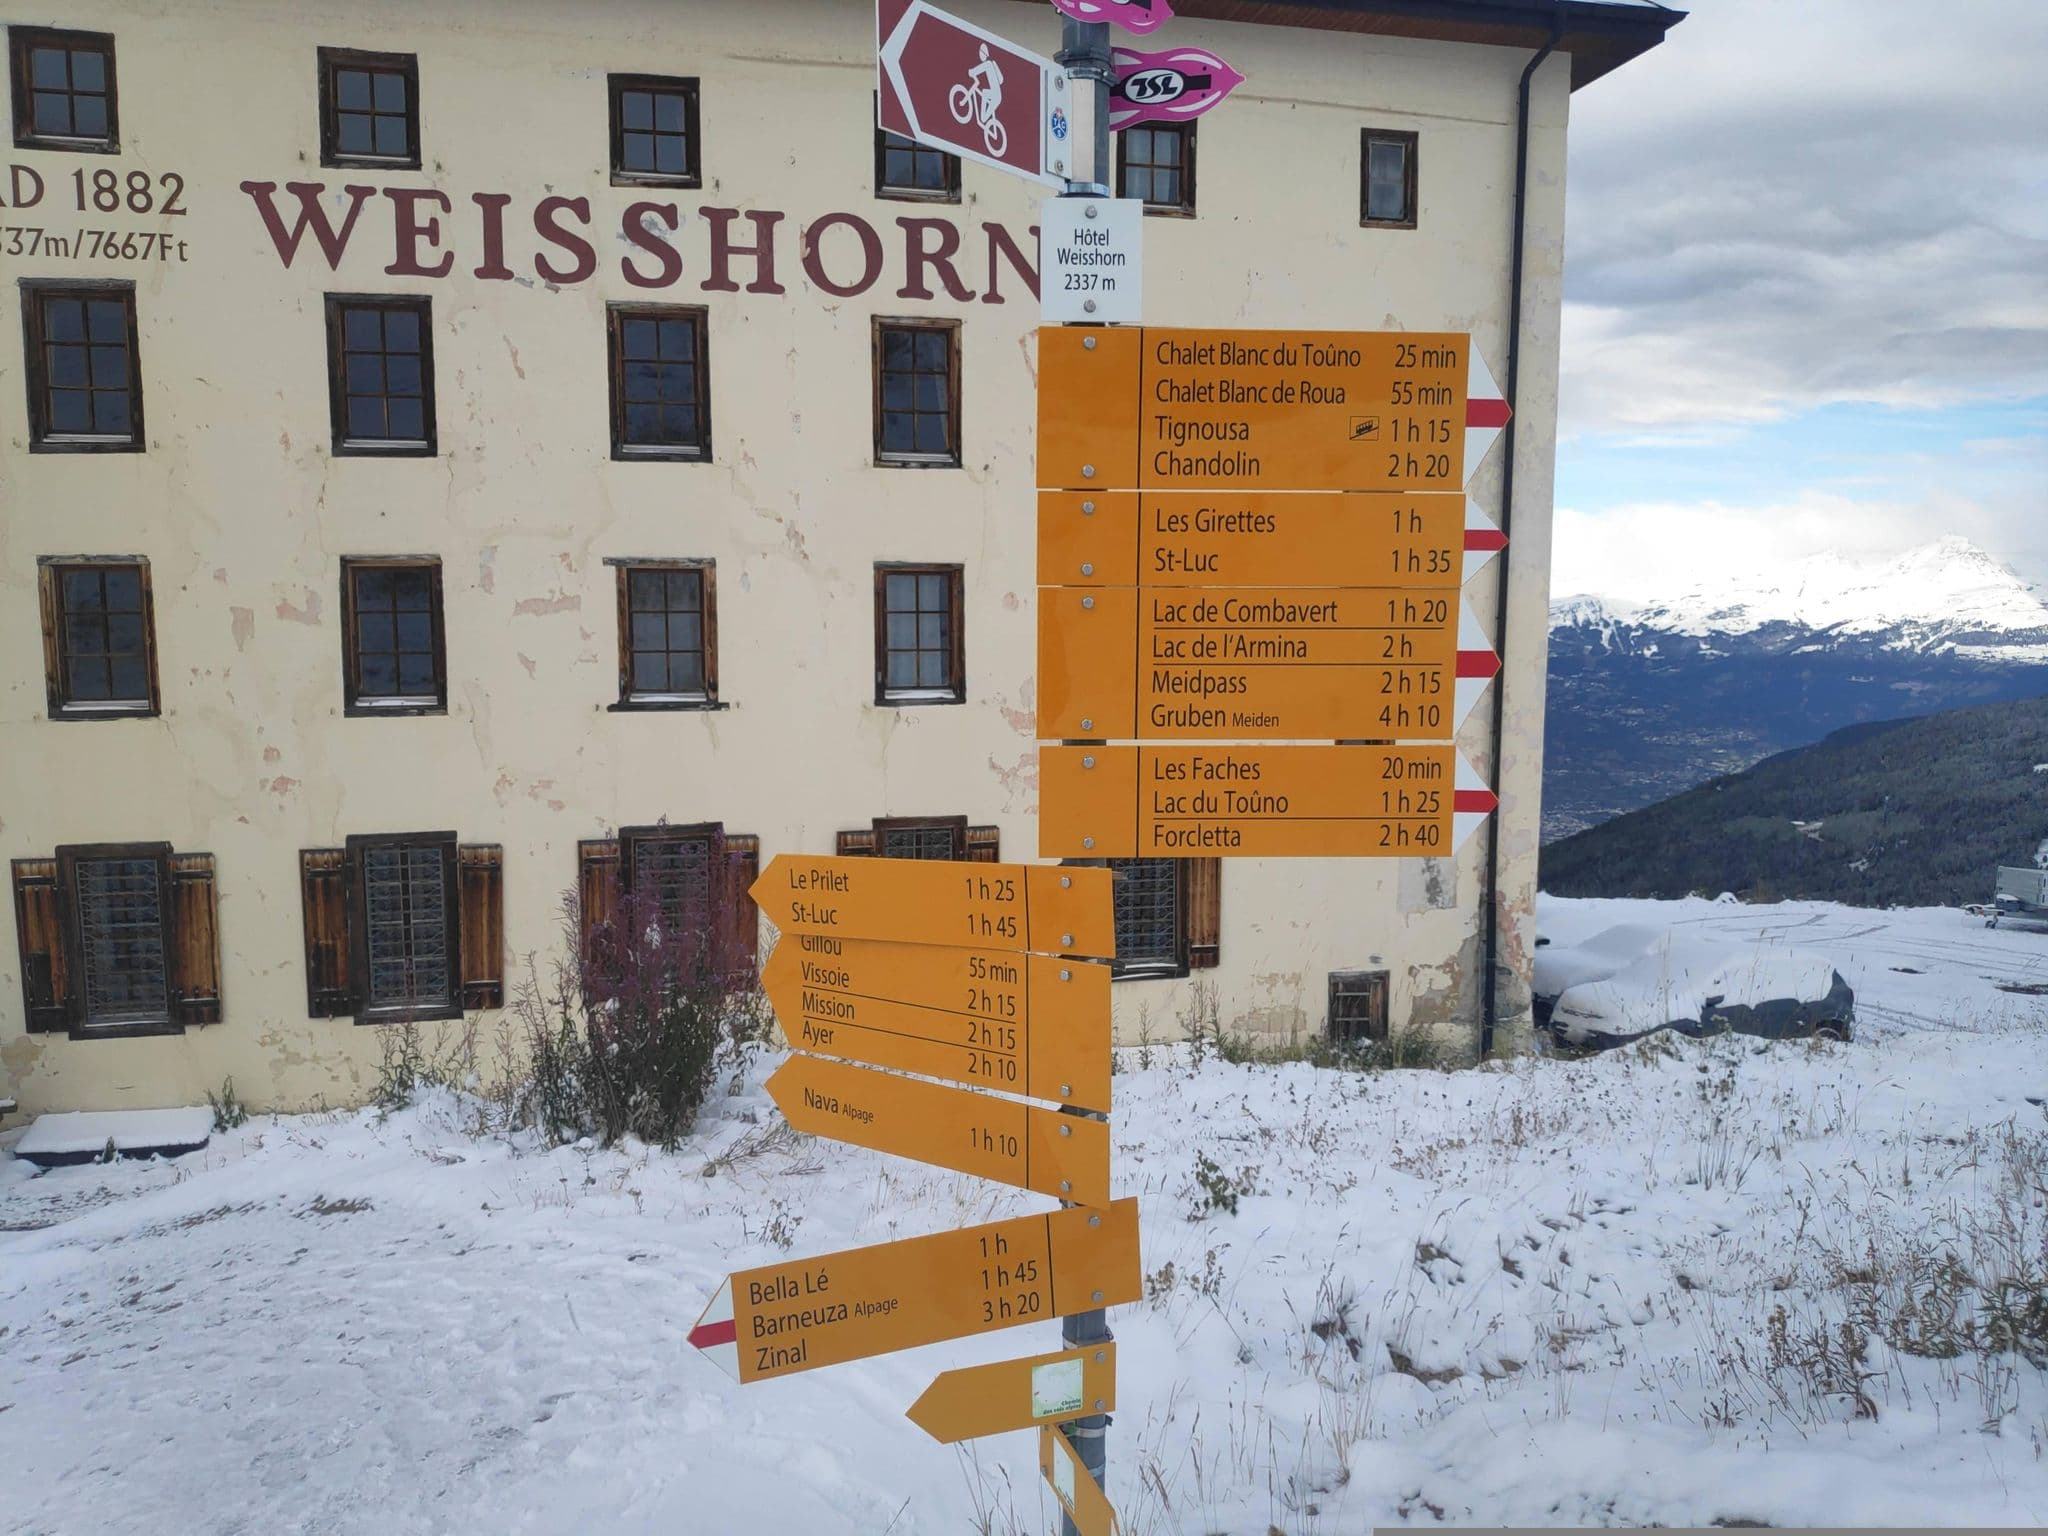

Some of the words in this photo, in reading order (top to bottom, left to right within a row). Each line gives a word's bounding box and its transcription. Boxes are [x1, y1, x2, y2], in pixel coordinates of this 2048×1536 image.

[1130, 73, 1179, 100] TSL
[0, 165, 44, 208] D
[72, 167, 186, 215] 1882
[0, 226, 188, 261] 37m/7667Ft
[1075, 228, 1109, 246] Hôtel
[1057, 248, 1126, 265] Weisshorn
[1064, 273, 1098, 291] 2337
[1102, 277, 1115, 291] m
[1157, 340, 1215, 365] Chalet
[1221, 341, 1269, 365] Blanc
[1274, 341, 1296, 366] du
[1302, 343, 1360, 367] Toûno
[1395, 343, 1416, 367] 25
[1422, 344, 1455, 368] min
[1156, 378, 1214, 403] Chalet
[1220, 378, 1267, 403] Blanc
[1272, 379, 1295, 403] de
[1301, 380, 1345, 404] Roua
[1391, 381, 1412, 404] 55
[1418, 381, 1451, 405] min
[1155, 415, 1249, 446] Tignousa
[1391, 418, 1398, 442] 1
[1408, 416, 1419, 442] h
[1429, 419, 1450, 442] 15
[1155, 449, 1259, 476] Chandolin
[1388, 453, 1399, 477] 2
[1407, 452, 1417, 477] h
[1425, 454, 1449, 477] 20
[1157, 508, 1188, 532] Les
[1196, 508, 1275, 532] Girettes
[1393, 510, 1401, 533] 1
[1410, 508, 1421, 533] h
[1155, 547, 1218, 571] St-Luc
[1391, 549, 1399, 572] 1
[1409, 548, 1419, 572] h
[1427, 549, 1450, 573] 35
[1154, 598, 1186, 622] Lac
[1193, 597, 1217, 622] de
[1225, 597, 1337, 622] Combavert
[1388, 599, 1395, 622] 1
[1405, 598, 1415, 622] h
[1423, 599, 1446, 622] 20
[1154, 634, 1185, 657] Lac
[1192, 633, 1217, 657] de
[1383, 635, 1393, 657] 2
[1401, 635, 1412, 657] h
[1153, 669, 1246, 699] Meidpass
[1381, 671, 1392, 693] 2
[1399, 671, 1410, 693] h
[1420, 671, 1440, 693] 15
[1152, 703, 1225, 727] Gruben
[1233, 711, 1279, 727] Meiden
[1379, 704, 1391, 726] 4
[1398, 703, 1408, 726] h
[1418, 704, 1439, 727] 10
[1155, 757, 1185, 780] Les
[1193, 755, 1260, 780] Faches
[1382, 757, 1403, 779] 20
[1408, 757, 1441, 779] min
[1155, 790, 1186, 813] Lac
[1193, 789, 1217, 813] du
[1224, 789, 1288, 813] Toûno
[1382, 791, 1389, 812] 1
[1399, 789, 1409, 812] h
[1417, 790, 1439, 813] 25
[1155, 824, 1240, 847] Forcletta
[1380, 824, 1390, 846] 2
[1398, 824, 1408, 846] h
[1415, 824, 1439, 846] 40
[791, 868, 806, 889] Le
[811, 869, 849, 891] Prilet
[966, 877, 973, 899] 1
[980, 876, 989, 900] h
[995, 879, 1014, 901] 25
[792, 901, 837, 924] St-Luc
[967, 913, 974, 934] 1
[982, 912, 991, 936] h
[997, 916, 1016, 937] 45
[970, 956, 985, 978] 55
[990, 961, 1017, 984] min
[802, 960, 849, 989] Vissoie
[968, 988, 976, 1010] 2
[982, 990, 991, 1012] h
[998, 993, 1015, 1016] 15
[802, 991, 855, 1020] Mission
[968, 1021, 976, 1042] 2
[983, 1023, 991, 1045] h
[998, 1027, 1015, 1049] 15
[802, 1021, 834, 1047] Ayer
[968, 1052, 976, 1073] 2
[983, 1054, 991, 1076] h
[999, 1058, 1016, 1081] 10
[805, 1086, 838, 1113] Nava
[843, 1103, 873, 1124] Alpage
[970, 1127, 977, 1147] 1
[984, 1128, 992, 1151] h
[1000, 1134, 1017, 1157] 10
[750, 1275, 798, 1305] Bella
[806, 1267, 828, 1293] Lé
[979, 1236, 987, 1257] 1
[996, 1232, 1007, 1255] h
[753, 1302, 847, 1338] Barneuza
[855, 1298, 897, 1318] Alpage
[981, 1269, 989, 1289] 1
[998, 1264, 1008, 1287] h
[1015, 1259, 1036, 1282] 45
[757, 1338, 806, 1371] Zinal
[983, 1300, 993, 1322] 3
[1000, 1296, 1011, 1318] h
[1018, 1291, 1039, 1315] 20
